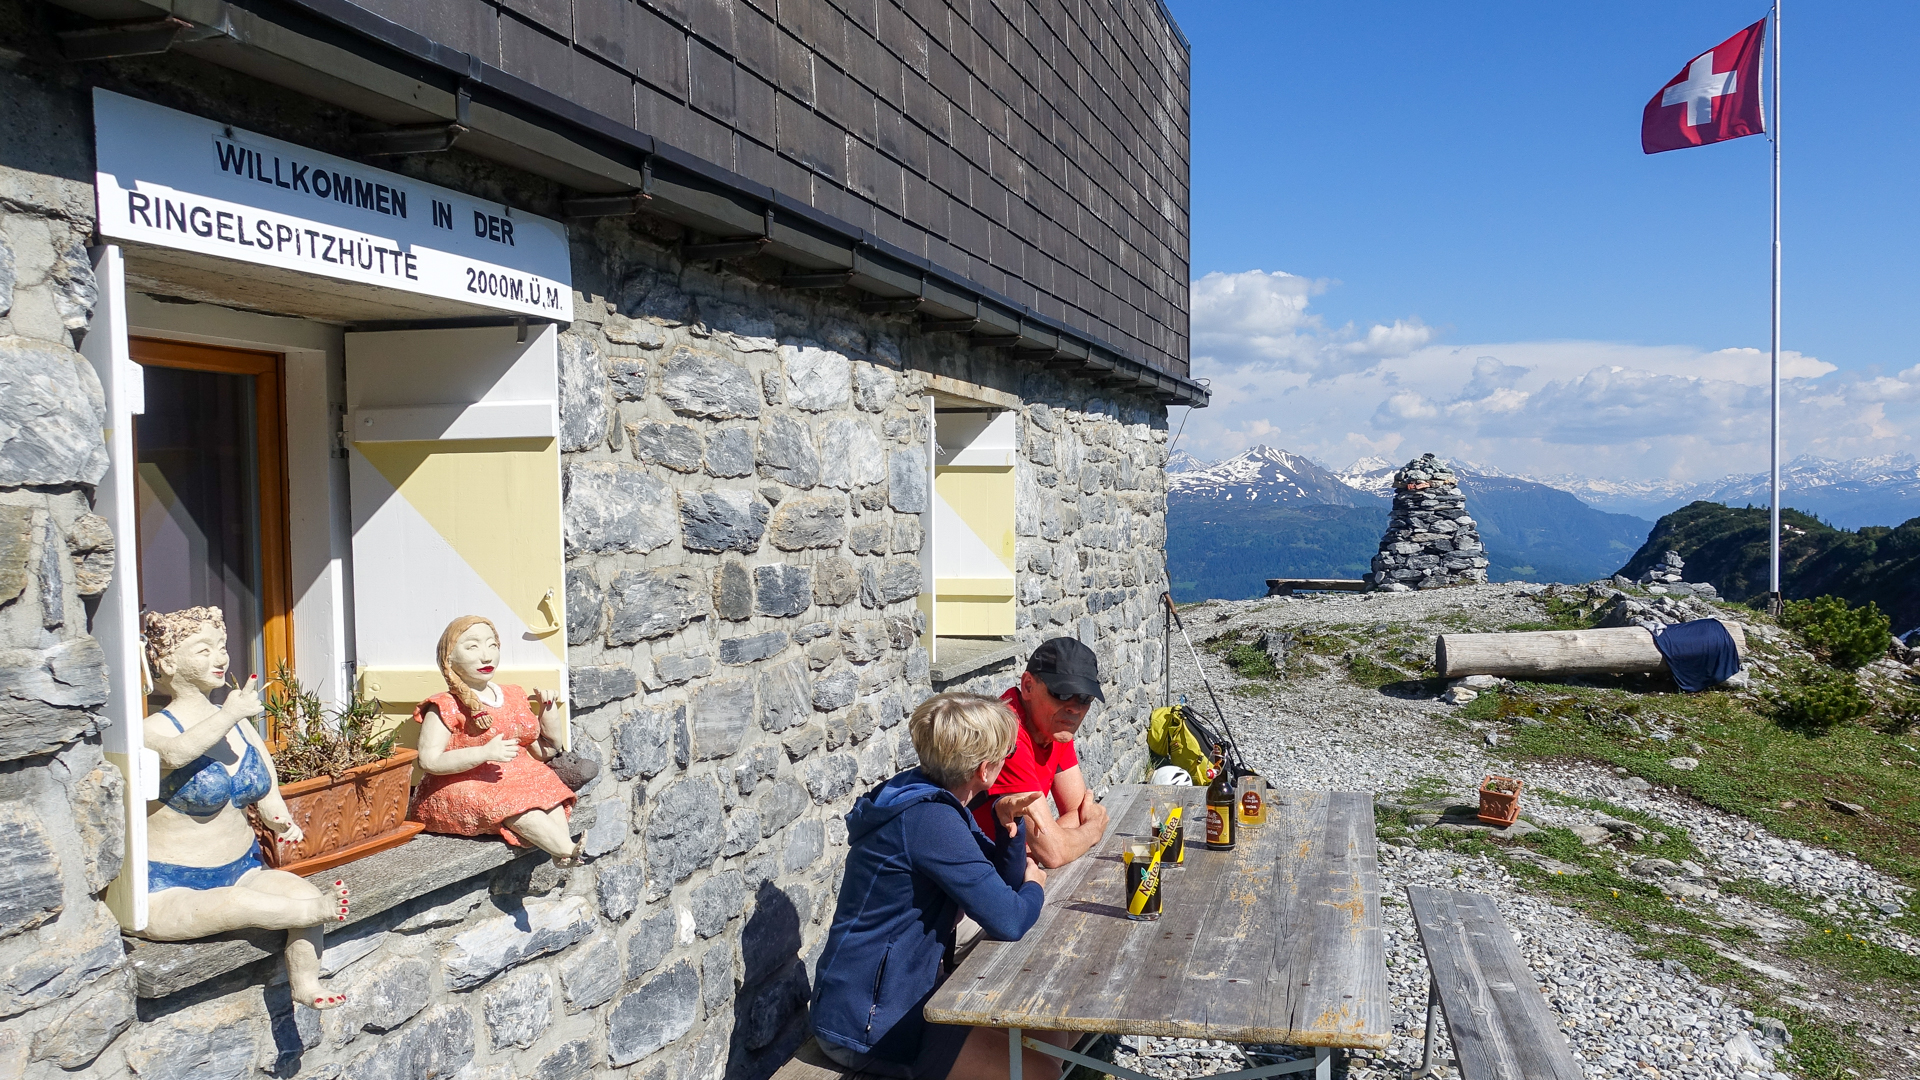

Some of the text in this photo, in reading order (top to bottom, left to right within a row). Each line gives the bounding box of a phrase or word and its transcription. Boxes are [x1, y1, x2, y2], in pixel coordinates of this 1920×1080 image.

[128, 191, 419, 281] RINGELSPITZHÜTTE
[214, 140, 516, 247] WILLKOMMEN IN DER
